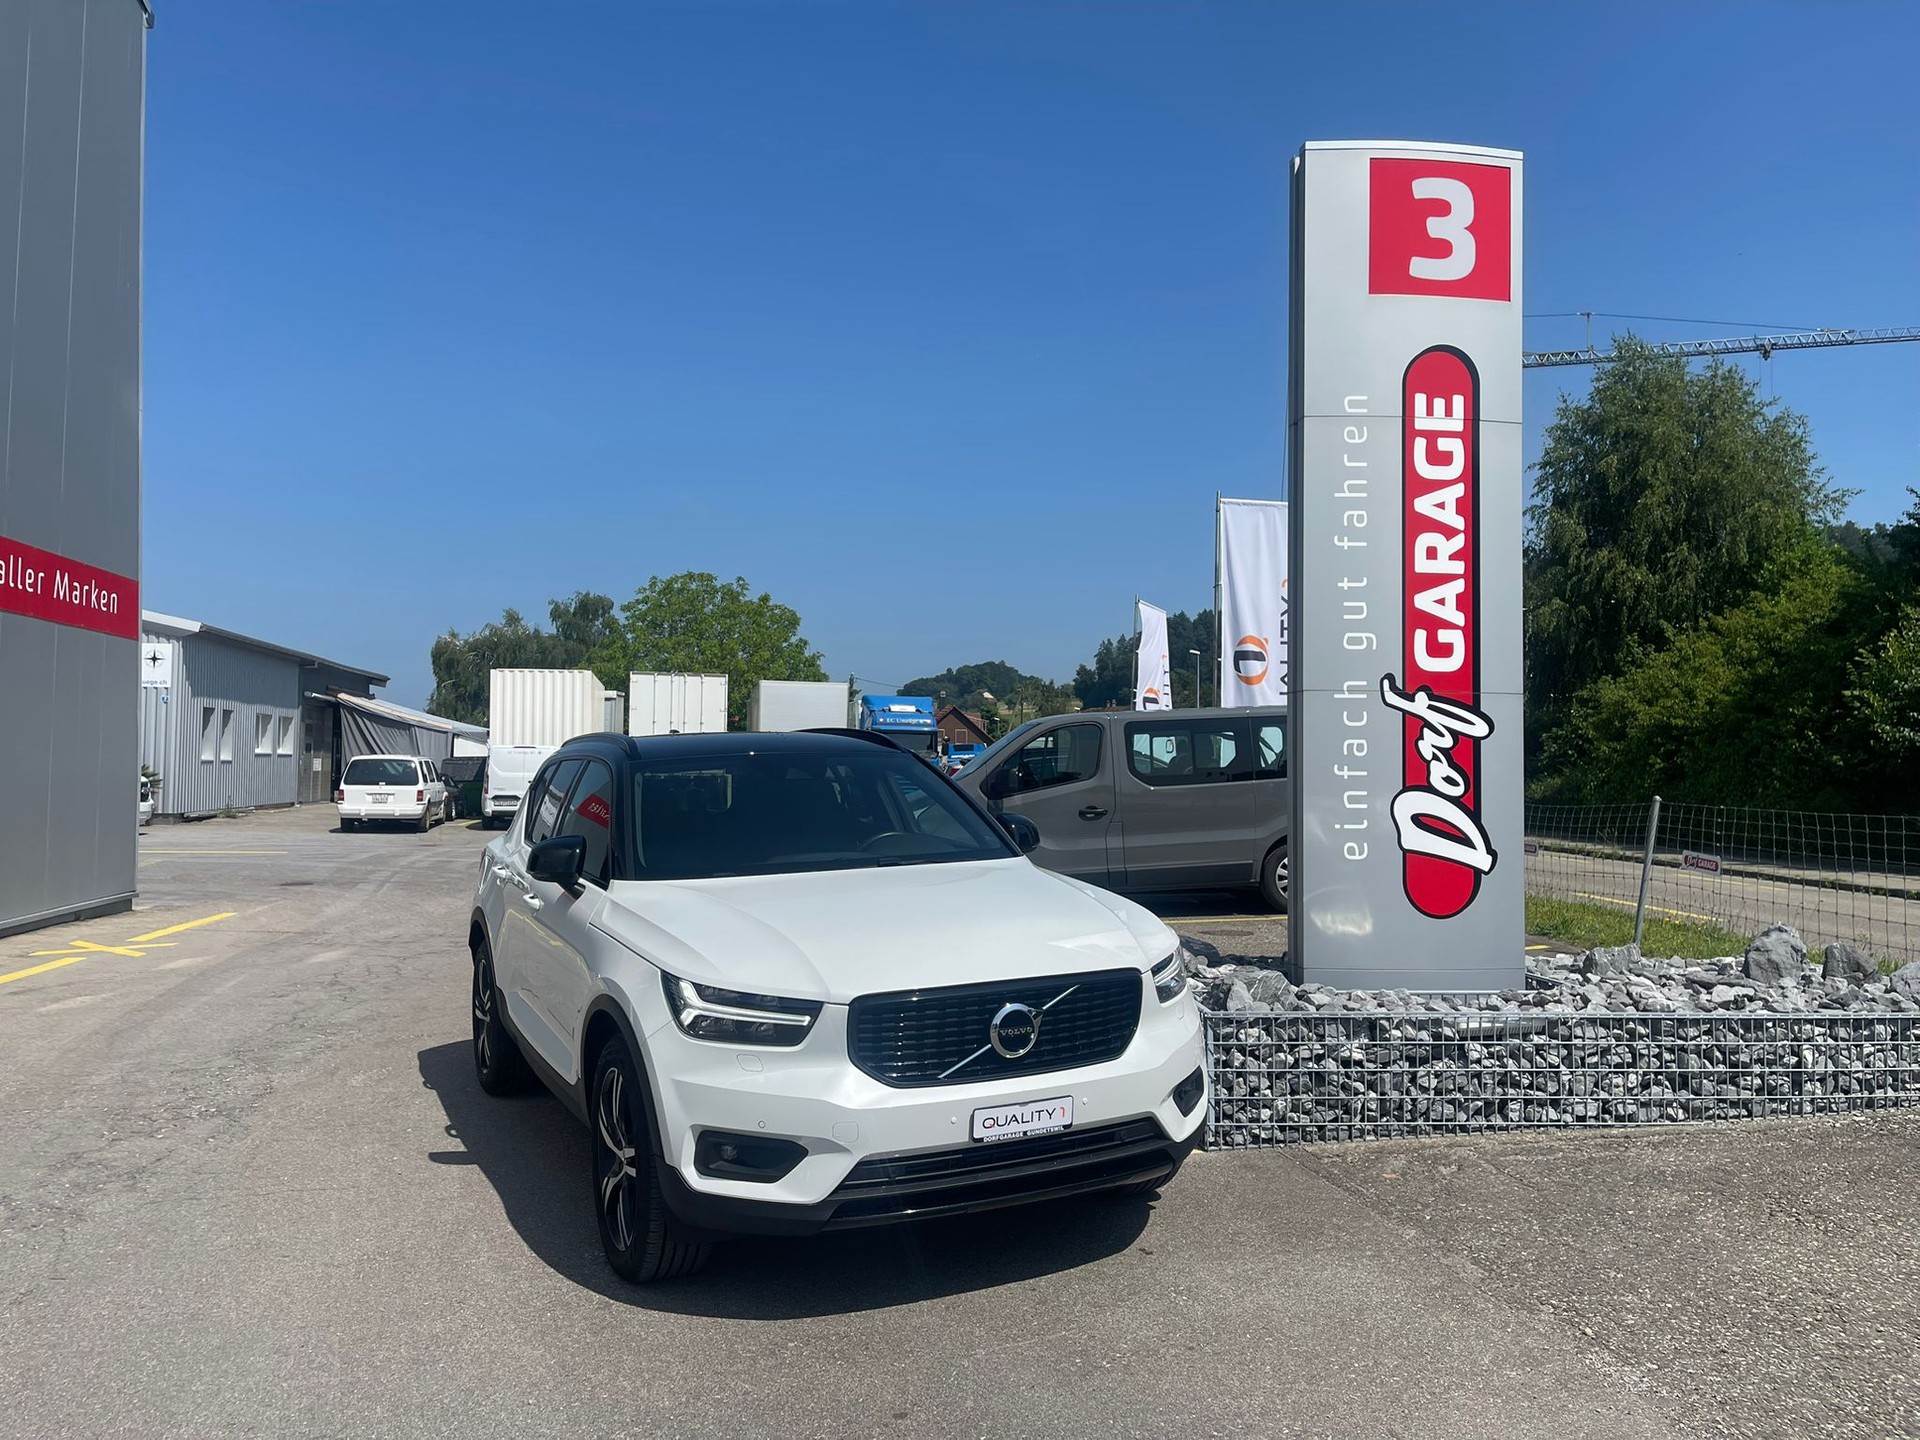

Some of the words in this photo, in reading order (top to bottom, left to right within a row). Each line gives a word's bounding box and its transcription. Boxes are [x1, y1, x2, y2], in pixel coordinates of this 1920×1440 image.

[1409, 177, 1476, 281] 3
[1334, 395, 1368, 550] fahren
[1414, 393, 1465, 672] GARAGE
[0, 555, 45, 594] aller
[53, 569, 118, 614] Marken
[1337, 577, 1377, 650] gut
[1334, 680, 1368, 860] einfach
[1381, 676, 1496, 874] Dorf
[1000, 1027, 1033, 1036] VOLVO
[982, 1107, 1056, 1129] QUALITY
[1060, 1106, 1065, 1118] 1
[983, 1131, 1024, 1143] DORFGARAGE
[1026, 1125, 1065, 1136] GUNDETSWIL
